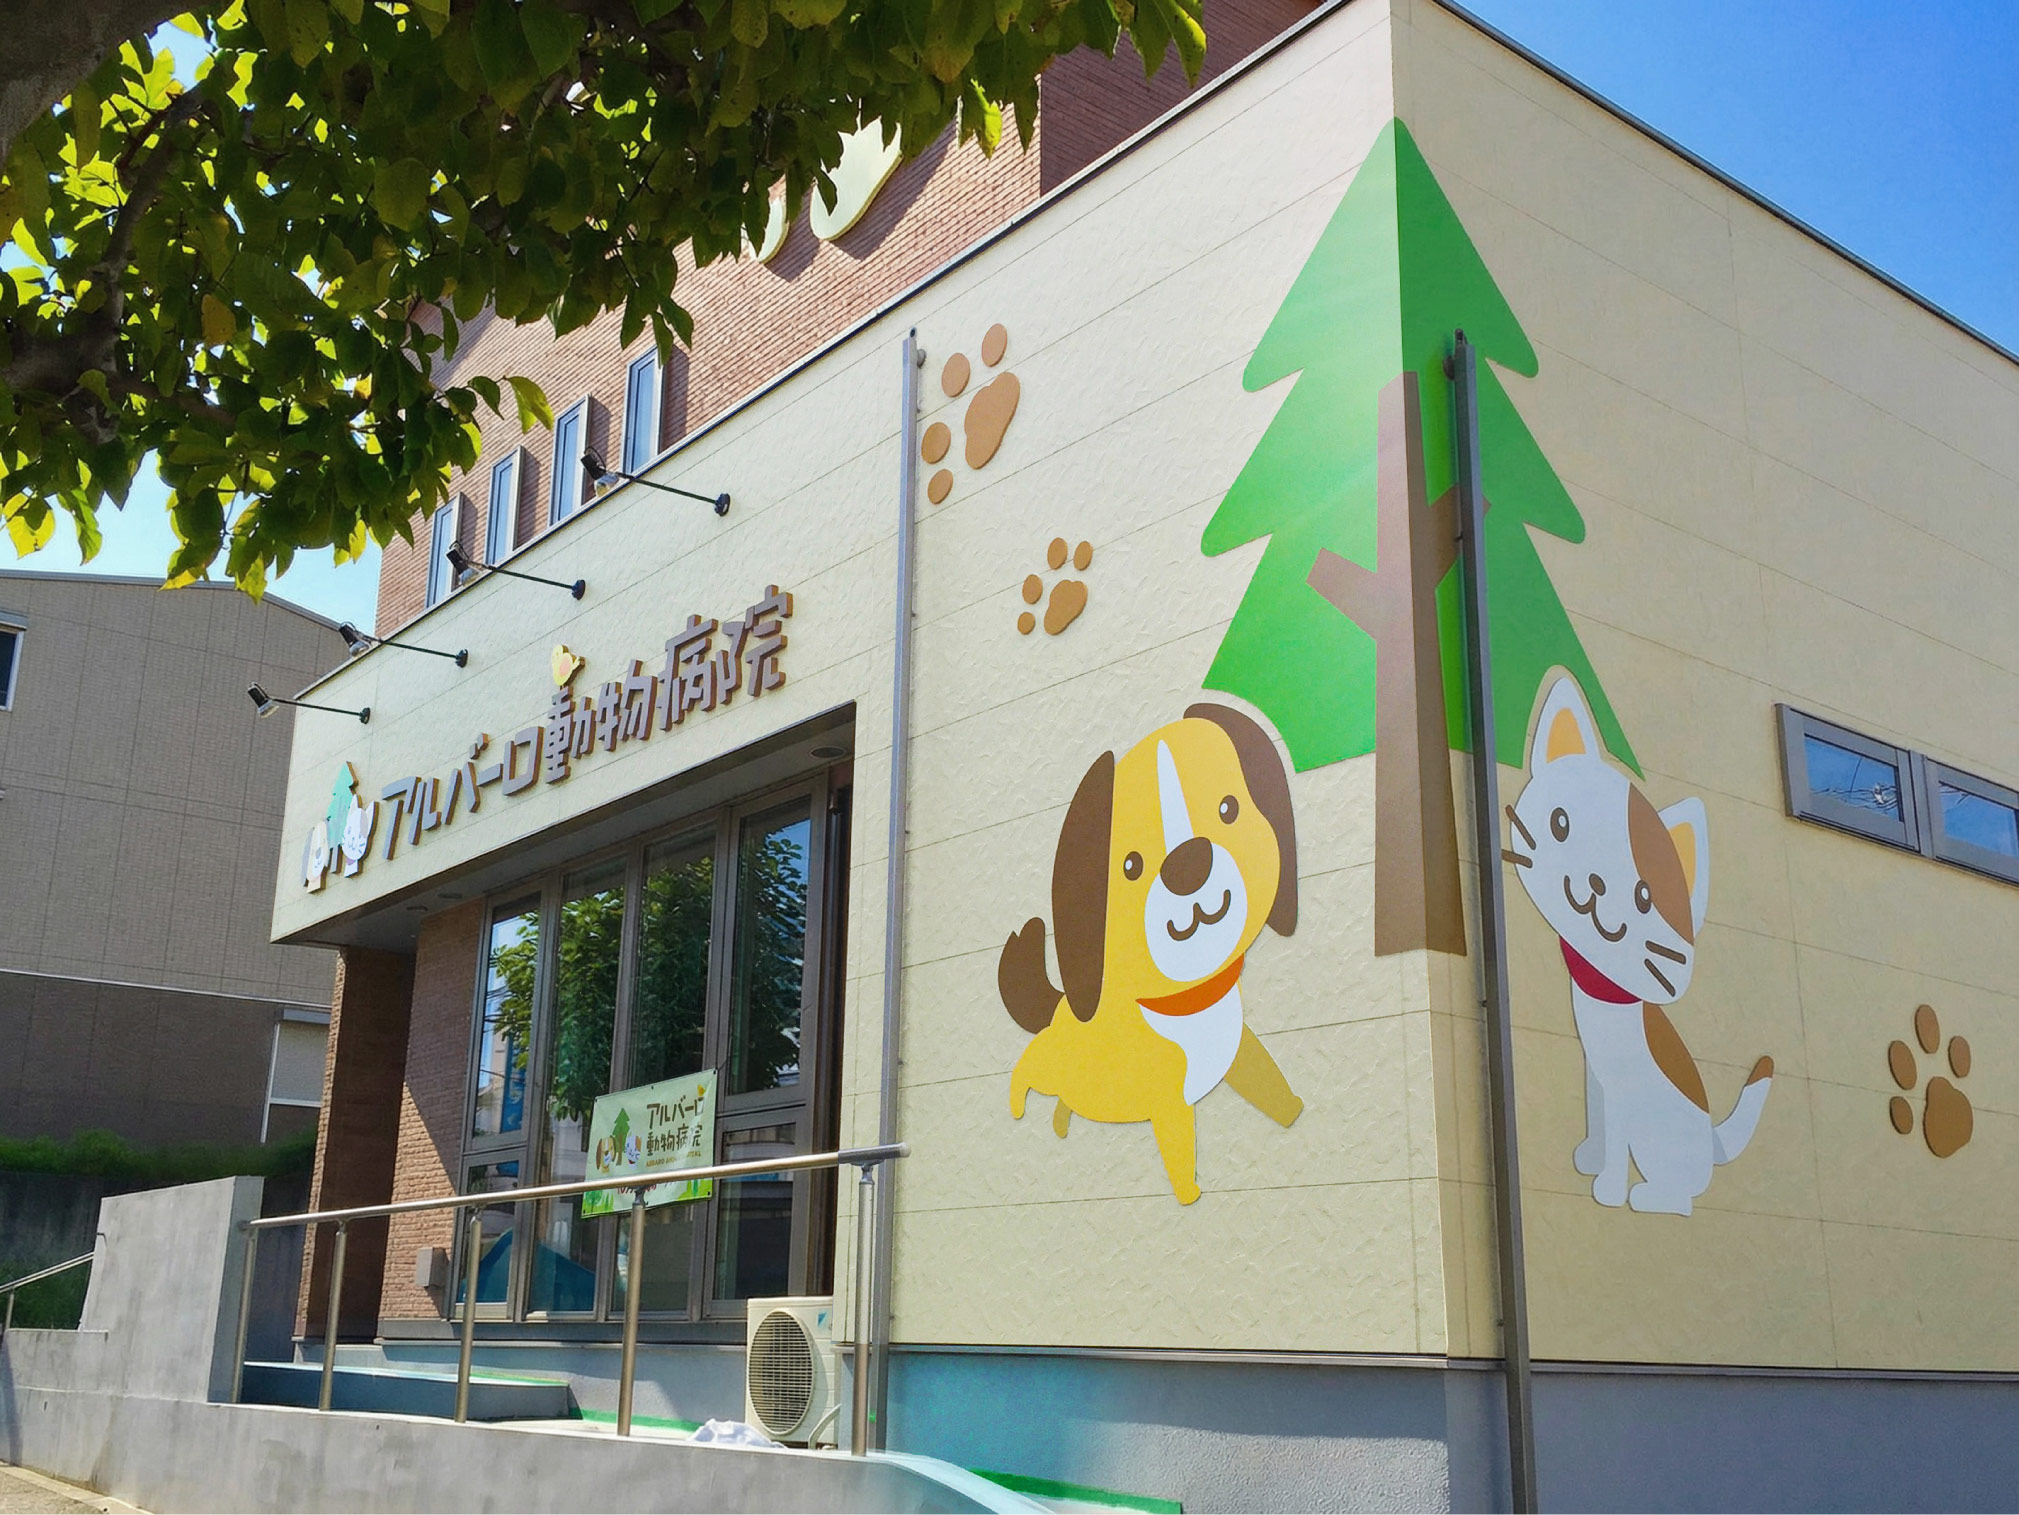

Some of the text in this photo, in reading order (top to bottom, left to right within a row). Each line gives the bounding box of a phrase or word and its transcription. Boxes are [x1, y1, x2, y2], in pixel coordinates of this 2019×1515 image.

[382, 585, 793, 860] アルバーロ動物病院
